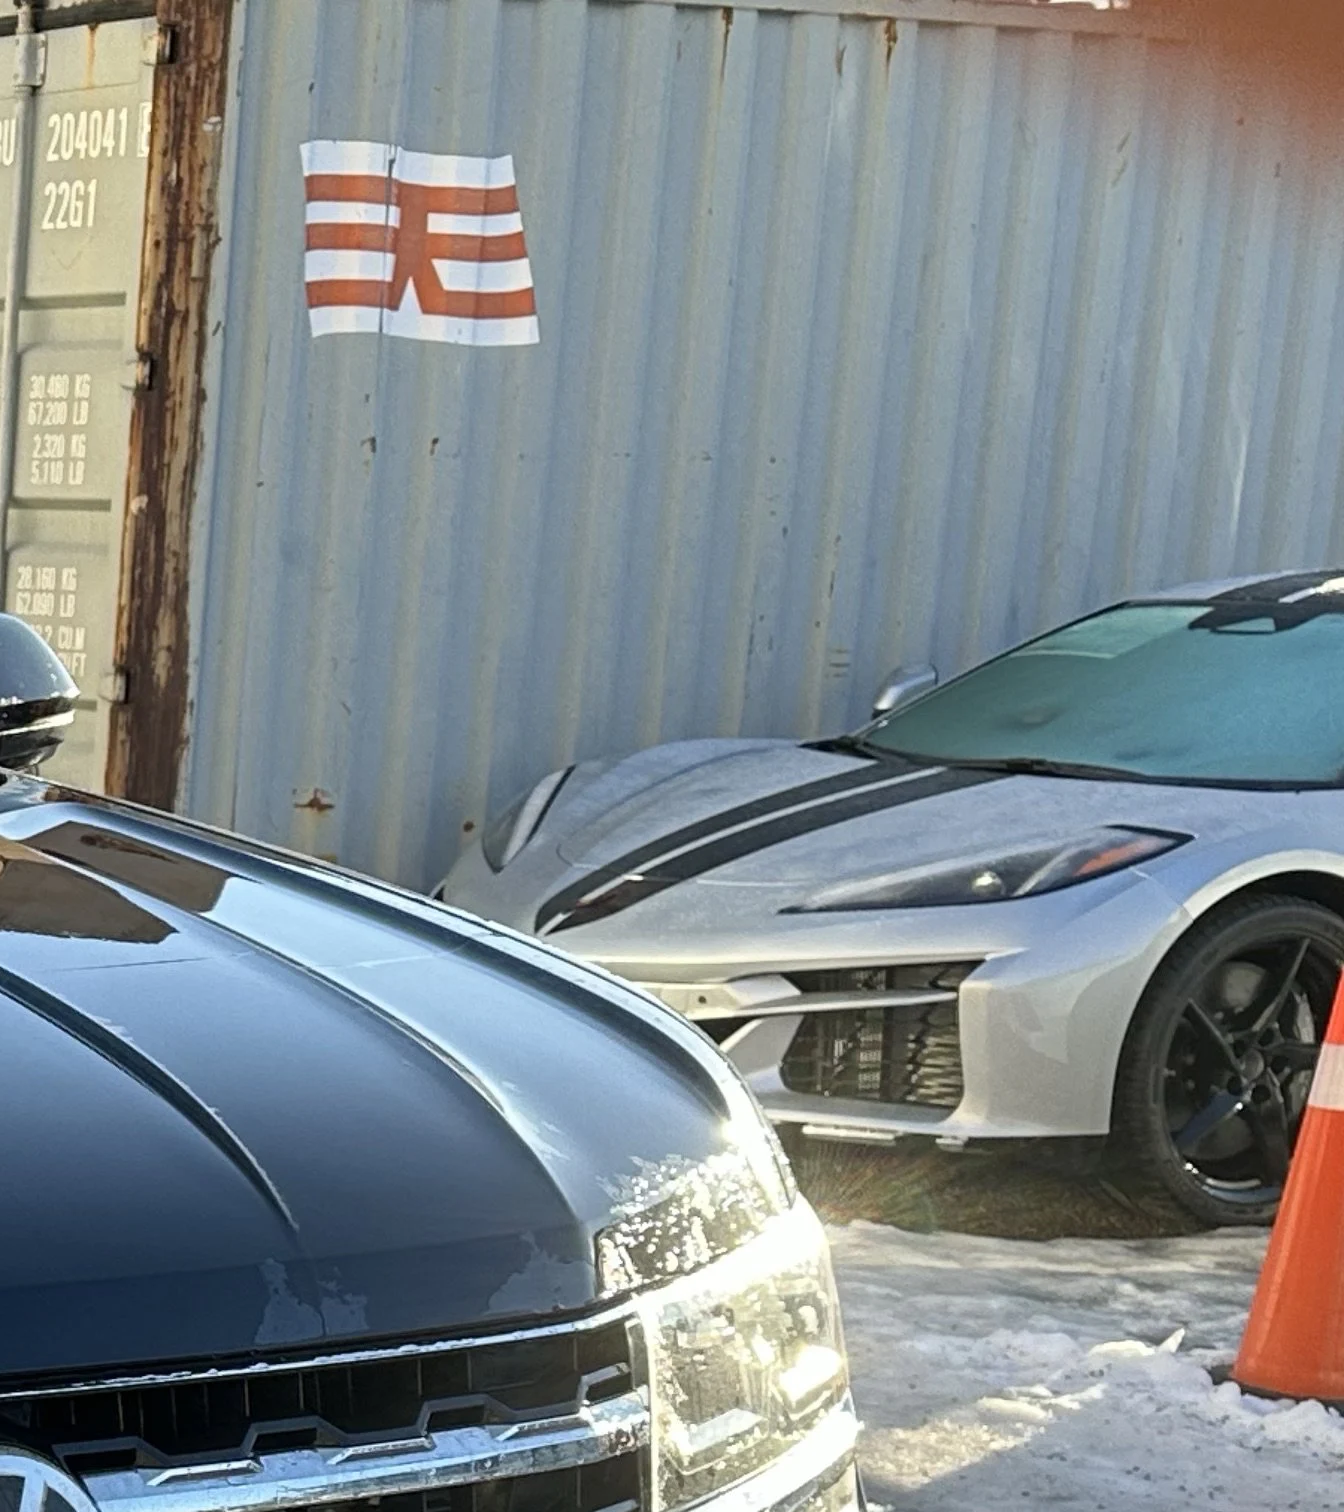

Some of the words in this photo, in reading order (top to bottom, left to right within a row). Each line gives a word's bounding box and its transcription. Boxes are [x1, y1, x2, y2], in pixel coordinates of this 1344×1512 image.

[46, 106, 128, 162] 204041
[41, 178, 98, 230] 22G1
[74, 373, 91, 399] KG
[72, 400, 89, 425] LB
[70, 433, 87, 458] KG
[68, 460, 85, 486] LB
[62, 567, 77, 592] KG
[59, 594, 76, 618] LB
